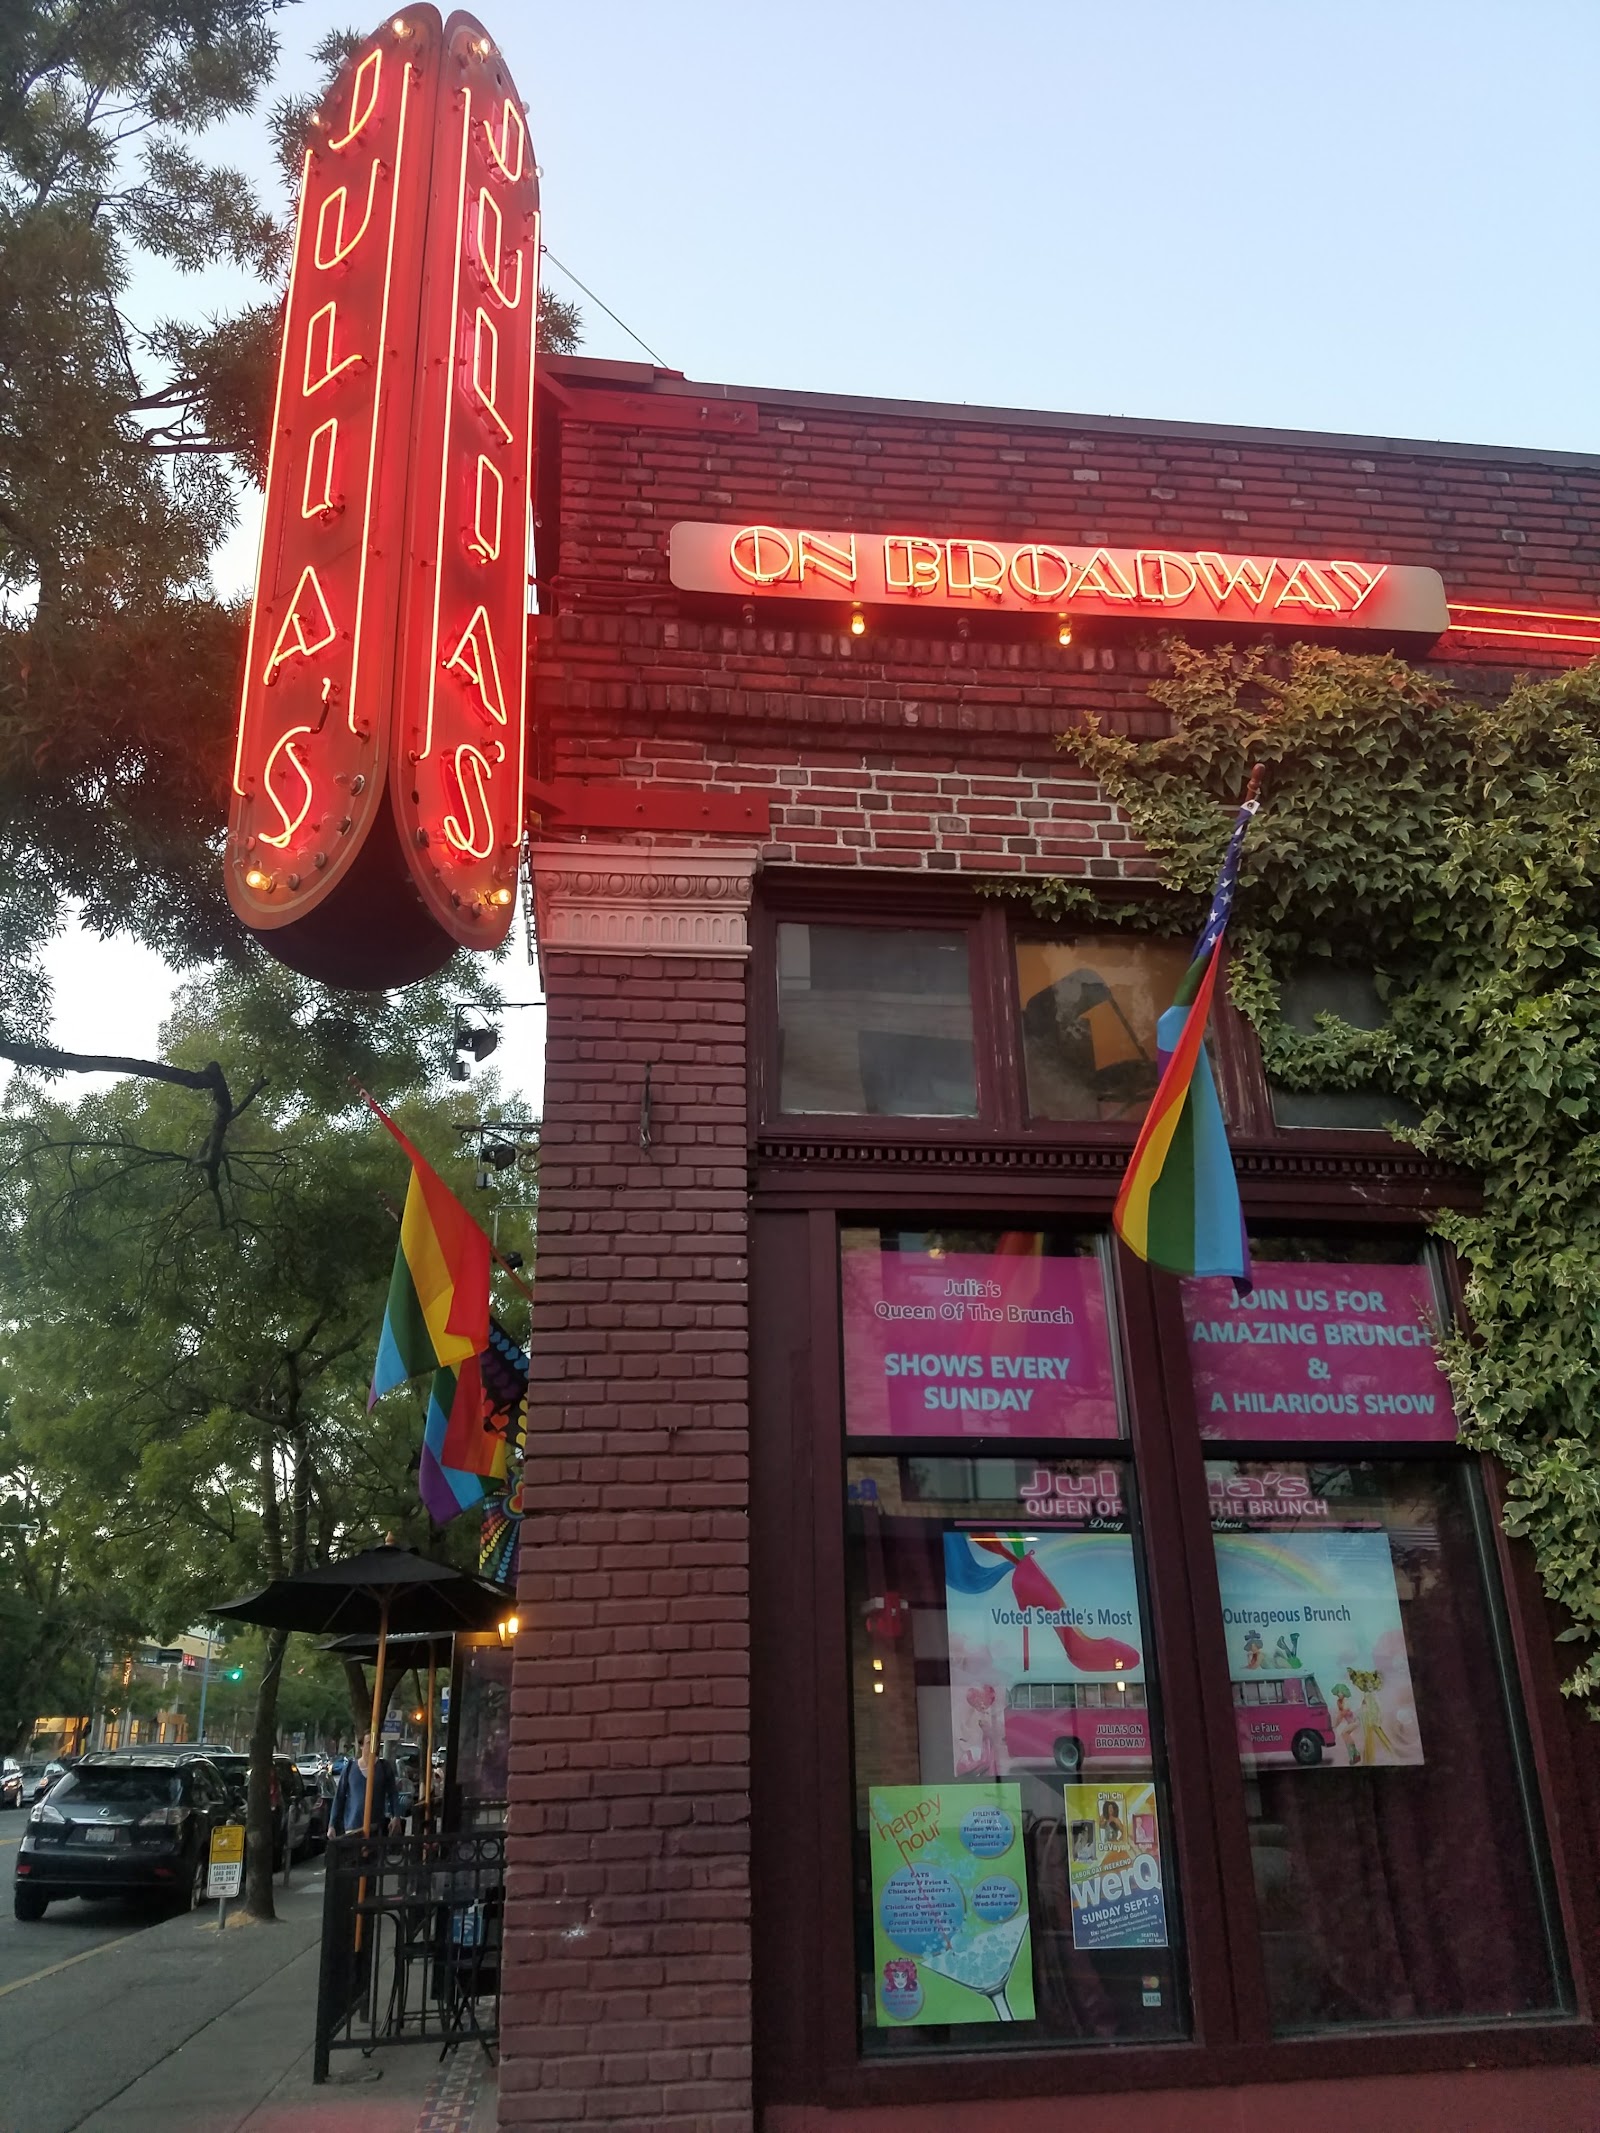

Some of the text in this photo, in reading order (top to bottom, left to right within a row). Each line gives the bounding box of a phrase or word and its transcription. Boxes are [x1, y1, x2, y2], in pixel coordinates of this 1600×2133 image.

[728, 524, 1389, 613] ON BROADWAY
[944, 1279, 1002, 1298] Julia's
[1229, 1289, 1387, 1313] JOIN US FOR
[874, 1301, 1074, 1325] Queen Of The Brunch
[1192, 1321, 1432, 1347] AMAZING BRUNCH
[884, 1353, 1070, 1380] SHOWS EVERY
[1307, 1357, 1331, 1380] &
[924, 1386, 1034, 1411] SUNDAY
[1210, 1392, 1435, 1415] A HILARIOUS SHOW
[1026, 1499, 1328, 1516] QUEEN OF THE BRUNCH
[1088, 1517, 1124, 1531] Drag
[992, 1605, 1351, 1628] Voted Seattle's Most Outrageous Brunch
[1097, 1724, 1143, 1735] JULIA'S ON
[1250, 1722, 1281, 1733] Le Faux
[1095, 1737, 1146, 1748] BROADWAY
[1097, 1791, 1124, 1800] Chi Chi
[872, 1793, 941, 1841] happy
[896, 1820, 940, 1854] hour
[1071, 1869, 1092, 1880] LABOR
[1092, 1866, 1103, 1875] DAY
[1104, 1858, 1132, 1871] WEEKEND
[1082, 1905, 1121, 1925] SUNDAY
[1124, 1897, 1151, 1913] SEPT.
[1153, 1894, 1160, 1905] 3
